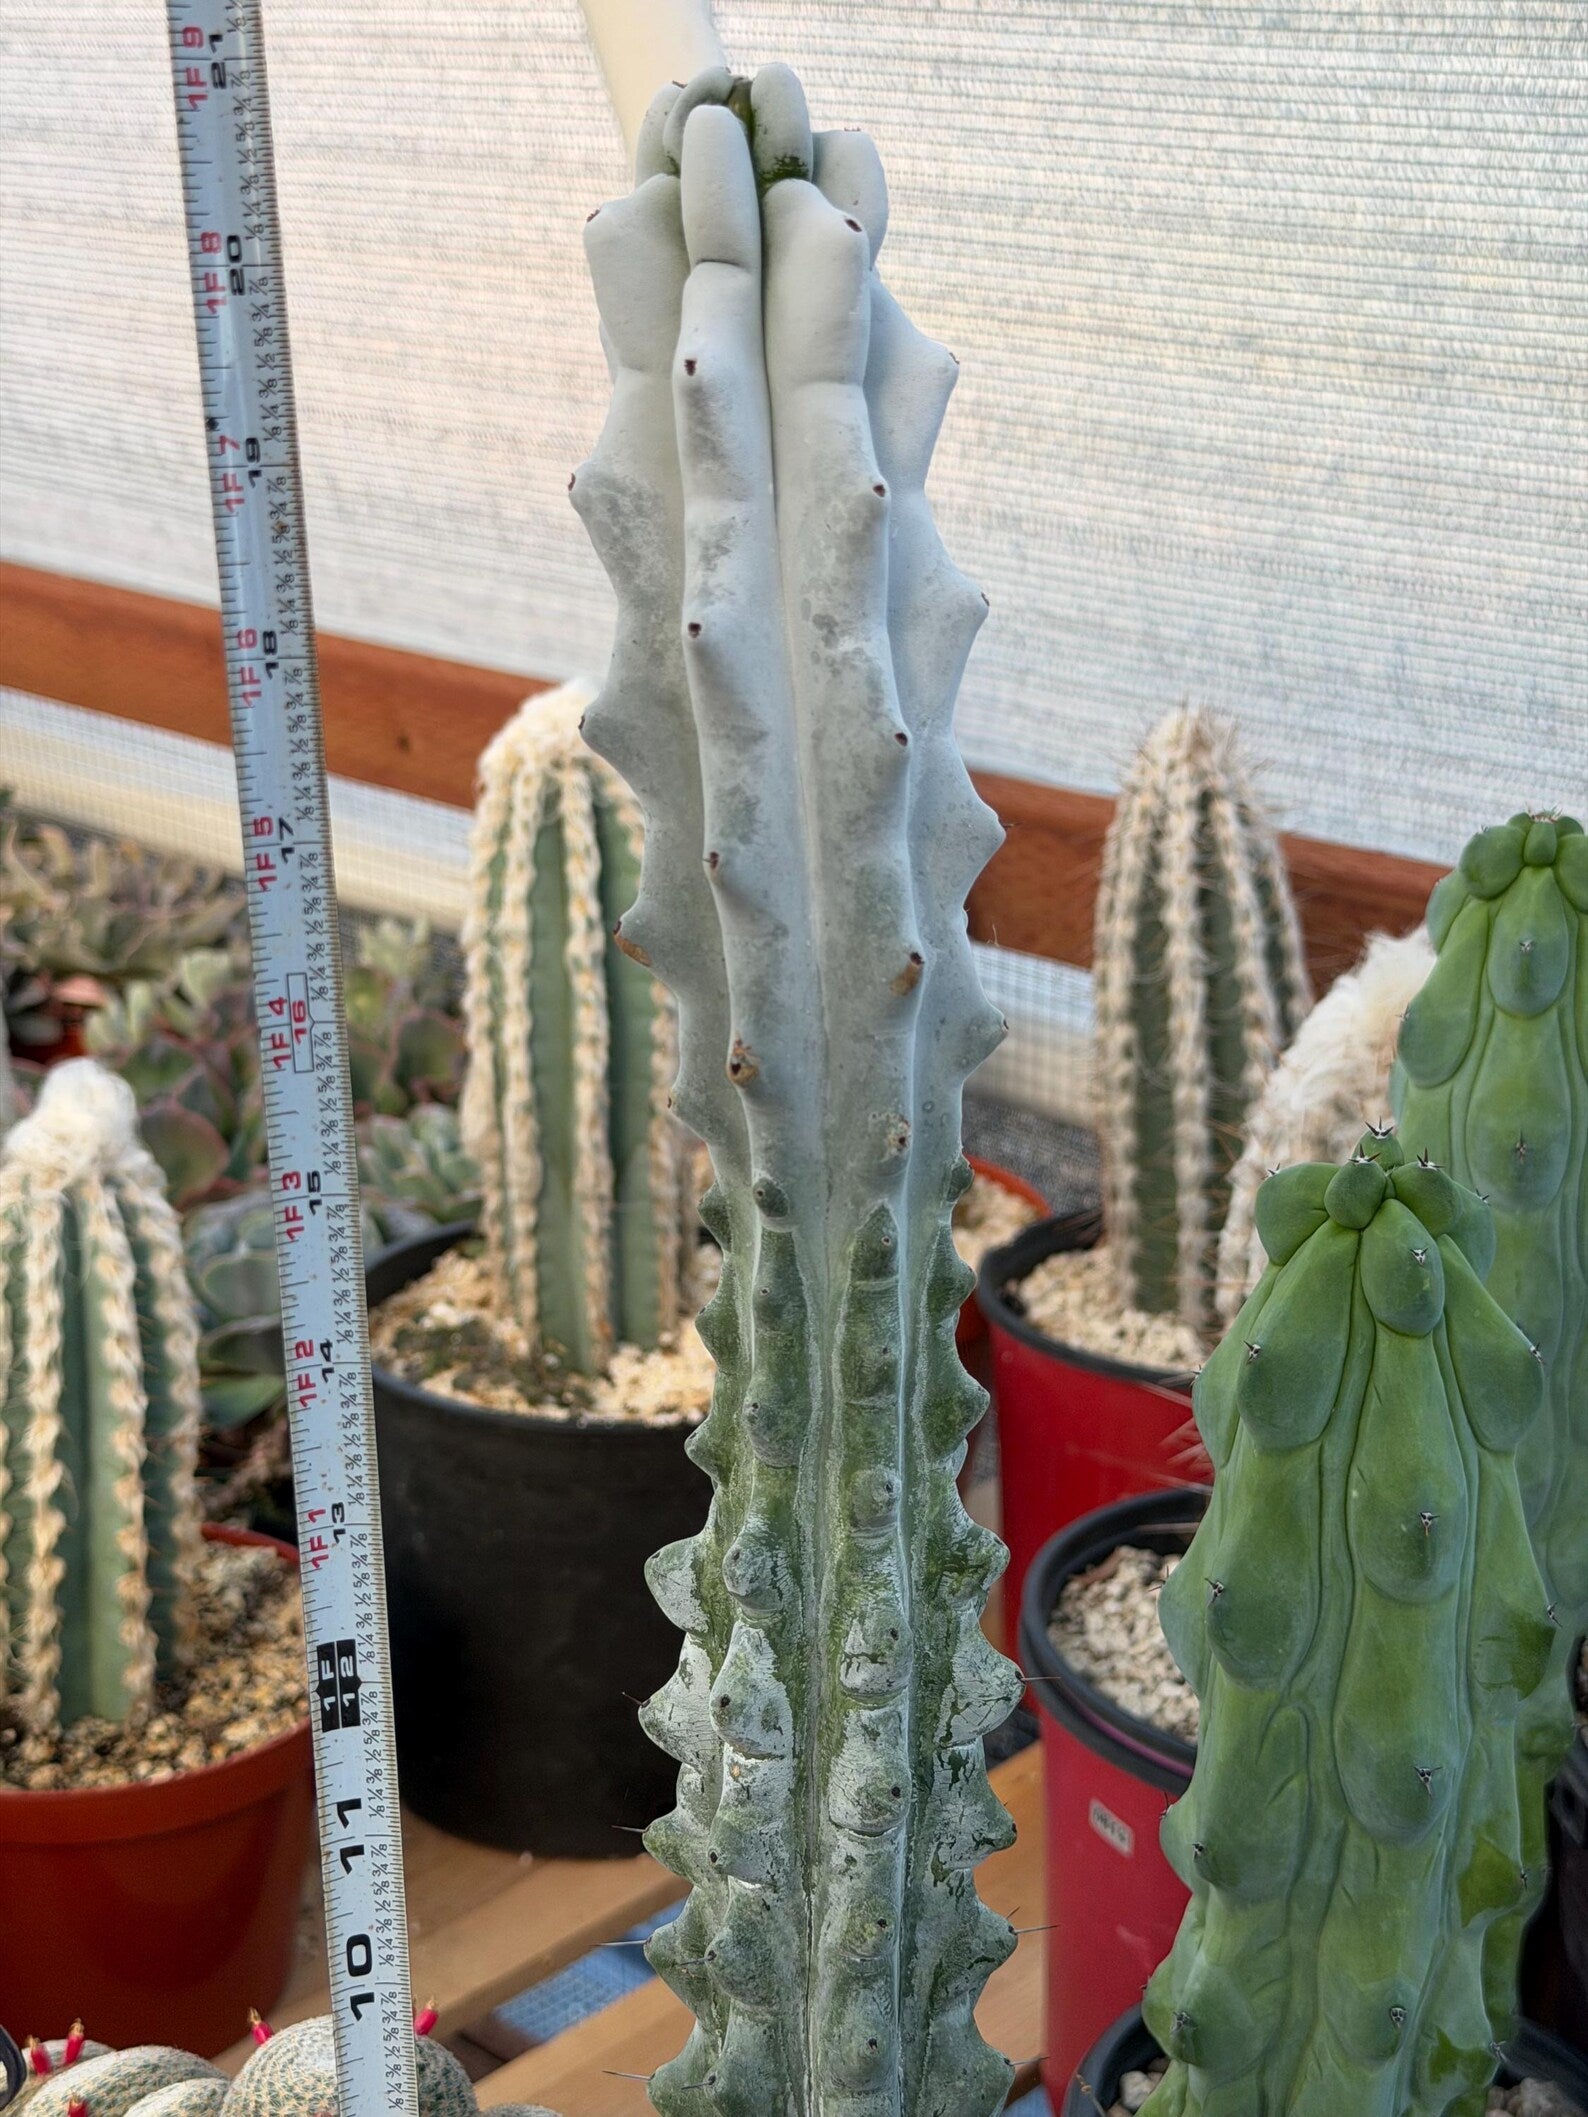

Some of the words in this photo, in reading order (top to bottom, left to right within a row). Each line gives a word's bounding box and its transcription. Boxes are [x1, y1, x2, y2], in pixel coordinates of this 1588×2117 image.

[209, 34, 227, 89] 21
[227, 235, 245, 295] 20
[246, 437, 261, 488] 19
[263, 630, 279, 680] 18
[279, 818, 294, 863] 17
[292, 1000, 307, 1044] 16
[307, 1170, 322, 1216] 15
[320, 1339, 334, 1383] 14
[332, 1502, 346, 1544] 13
[340, 1655, 355, 1707] 12
[336, 1798, 364, 1875] 11
[347, 1934, 374, 2021] 10
